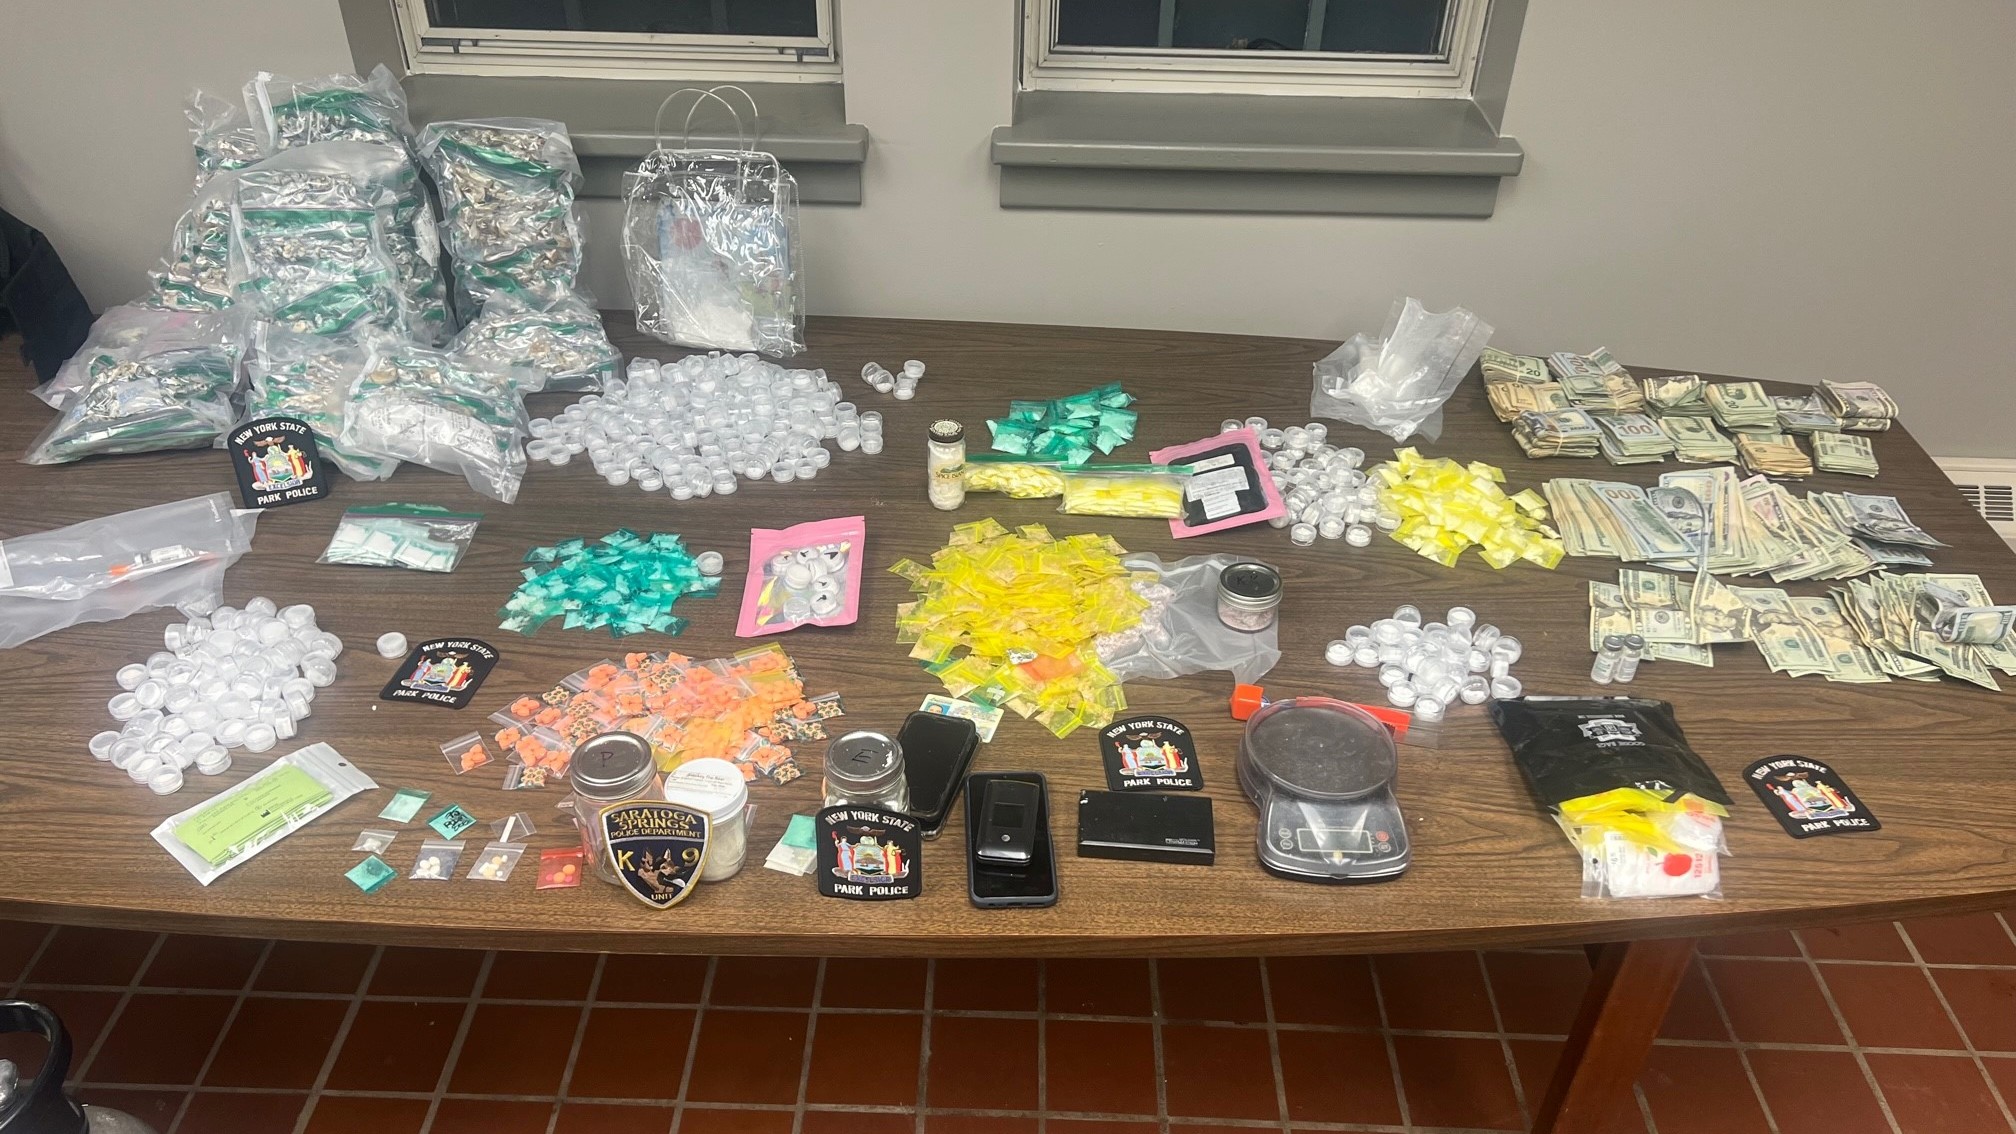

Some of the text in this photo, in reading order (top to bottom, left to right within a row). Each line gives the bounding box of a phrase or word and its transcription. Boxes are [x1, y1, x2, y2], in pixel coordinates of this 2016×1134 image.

[1525, 368, 1541, 377] 20
[234, 422, 307, 446] NEW YORK STATE
[1620, 424, 1654, 435] 100
[257, 486, 319, 505] PARK POLICE
[1604, 489, 1640, 500] 100
[421, 641, 495, 659] NEW YORK STATE
[392, 689, 457, 704] PARK POLICE
[1106, 720, 1185, 739] NEW YORK STATE
[600, 751, 614, 767] P
[1751, 759, 1828, 780] NEW YORK STATE
[1123, 778, 1193, 787] PARK POLICE
[611, 808, 698, 825] SARATOGA
[619, 818, 690, 830] SPRINGS
[825, 810, 915, 832] NEW YORK STATE
[610, 827, 702, 838] POLICE DEPARTMENT
[1801, 818, 1870, 832] PARK POLICE
[617, 847, 700, 872] K 9
[651, 892, 673, 901] UNIT
[834, 883, 909, 896] PARK POLICE
